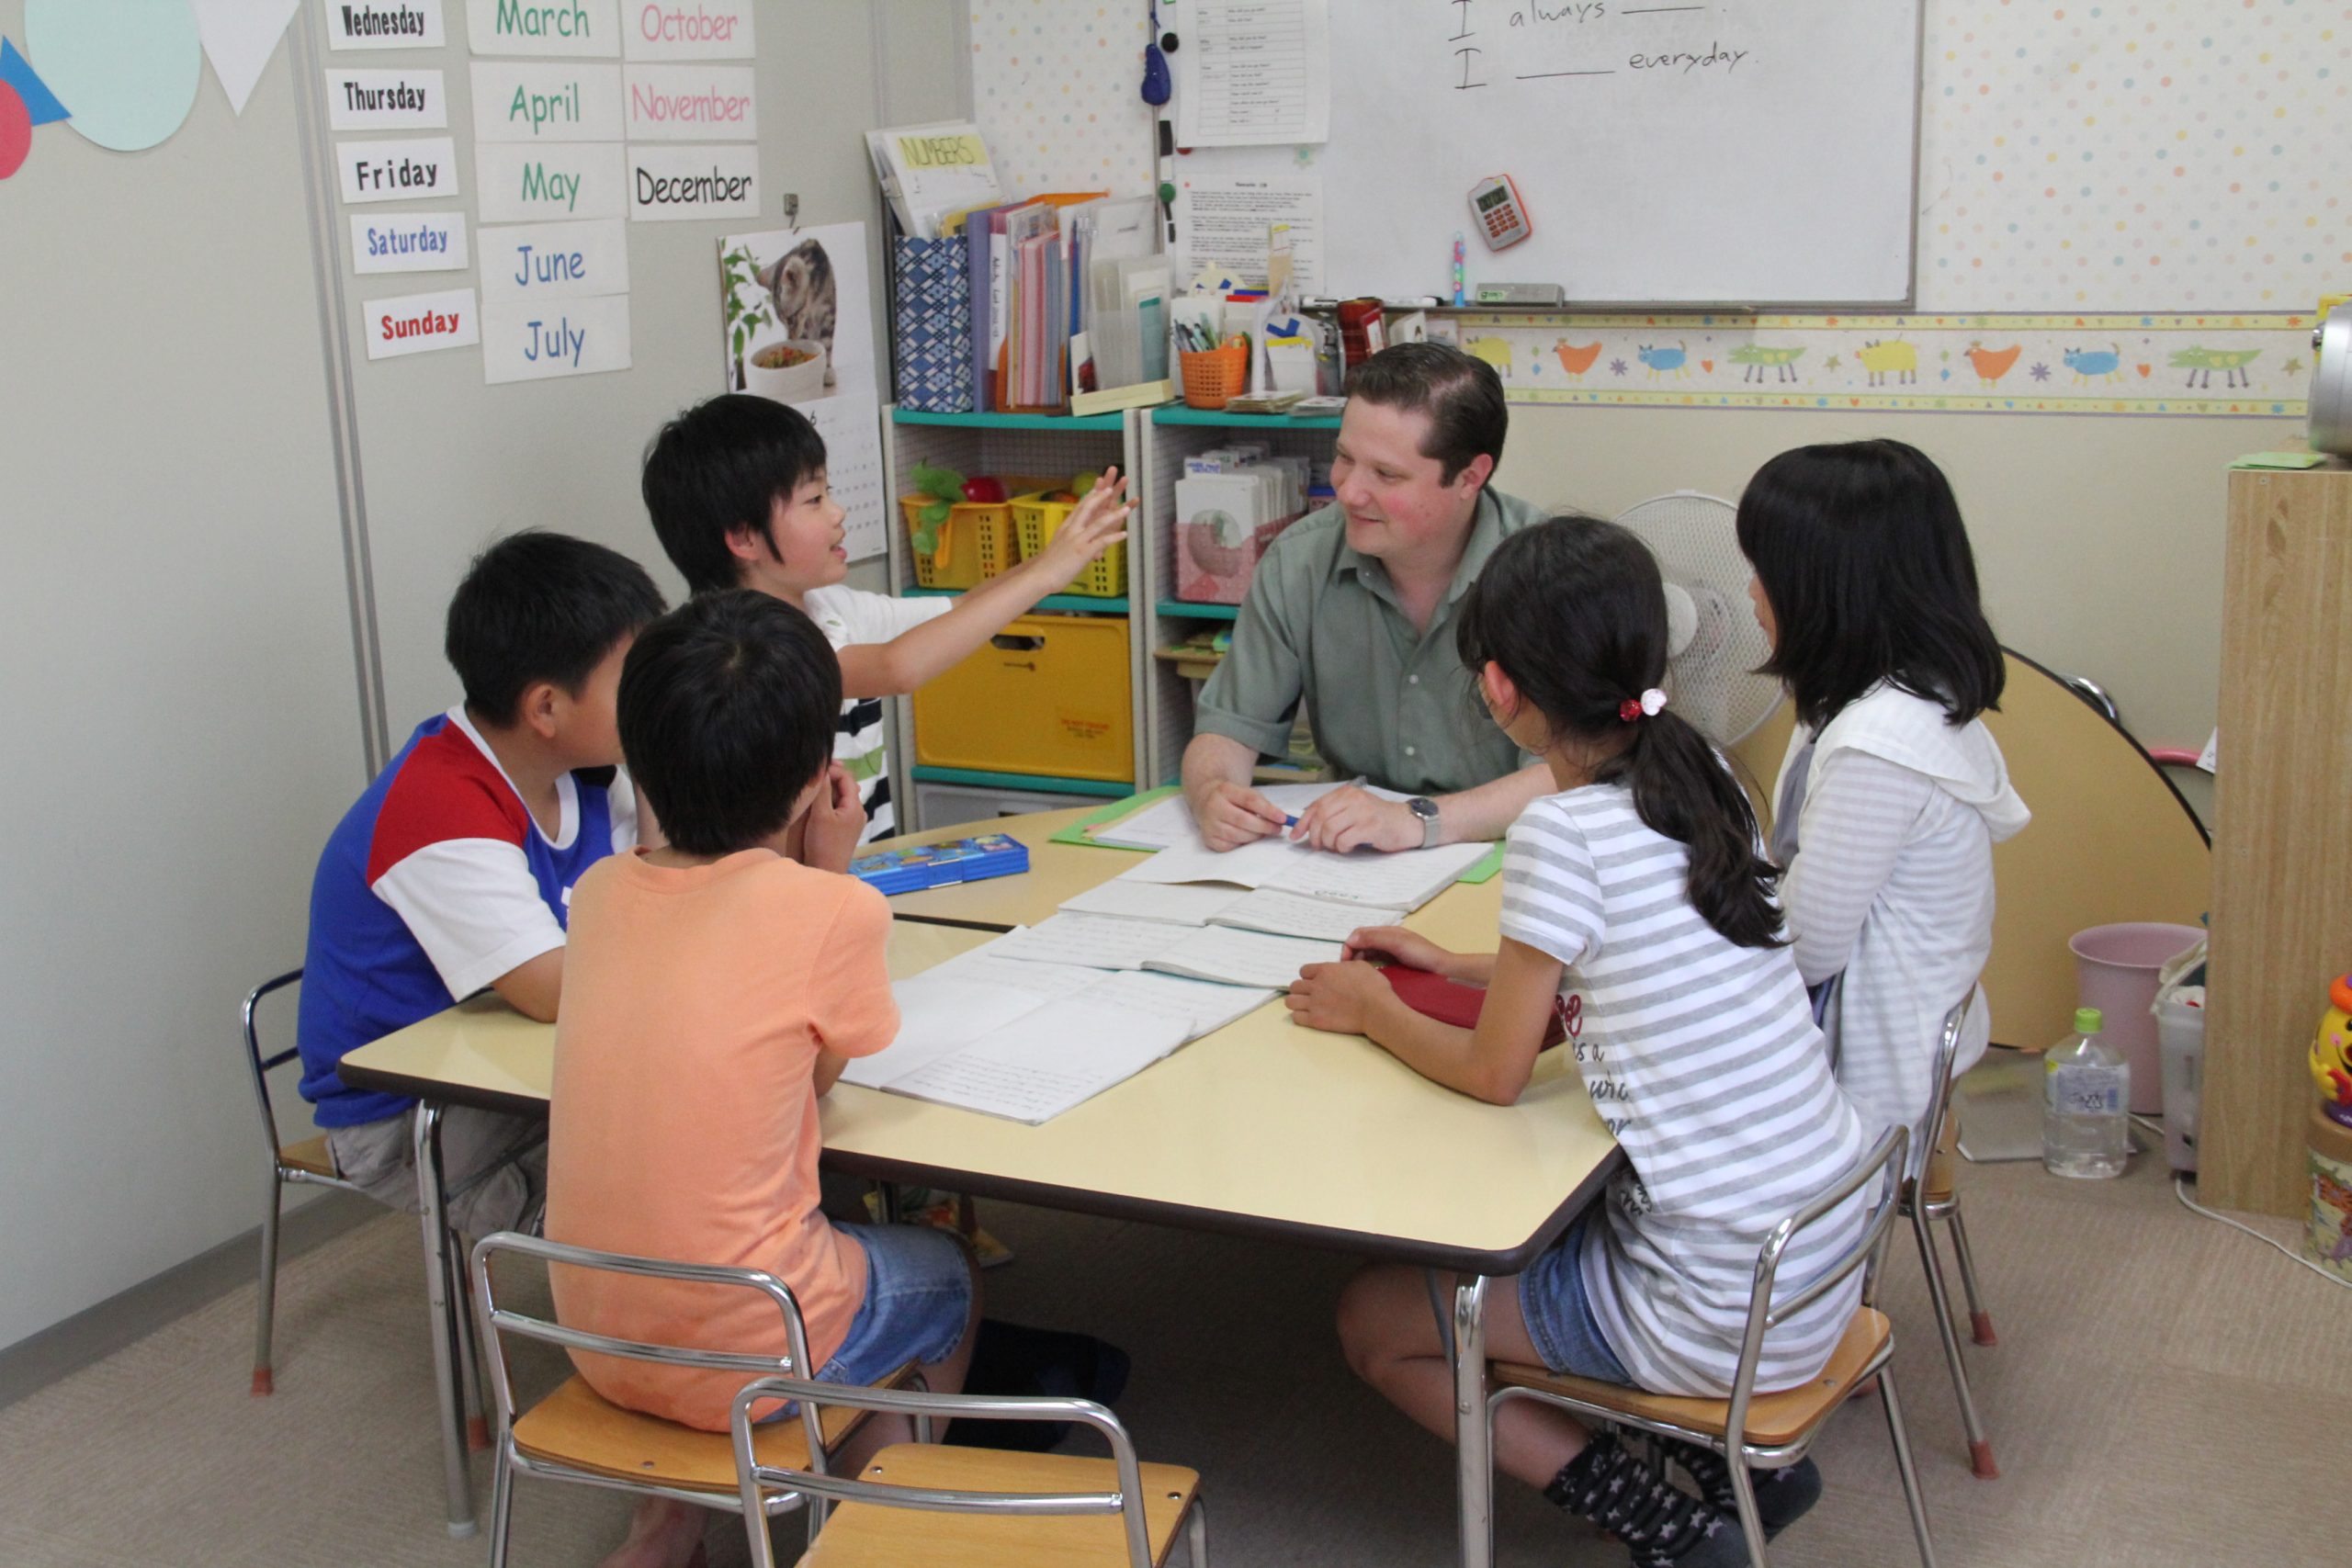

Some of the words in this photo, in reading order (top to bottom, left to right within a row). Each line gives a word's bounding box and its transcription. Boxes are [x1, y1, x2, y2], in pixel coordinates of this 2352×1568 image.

[342, 5, 425, 37] Wednesday
[496, 0, 590, 38] March
[641, 4, 738, 41] October
[1448, 0, 1475, 41] I
[1510, 0, 1605, 27] always
[1454, 48, 1487, 90] I
[344, 81, 425, 112] Thursday
[509, 83, 580, 135] April
[632, 84, 750, 121] November
[899, 137, 975, 165] NUMBERS
[356, 158, 437, 191] Friday
[521, 162, 581, 212] May
[636, 165, 752, 205] December
[368, 225, 447, 256] Saturday
[514, 245, 585, 288] June
[381, 310, 459, 341] Sunday
[525, 317, 585, 367] July
